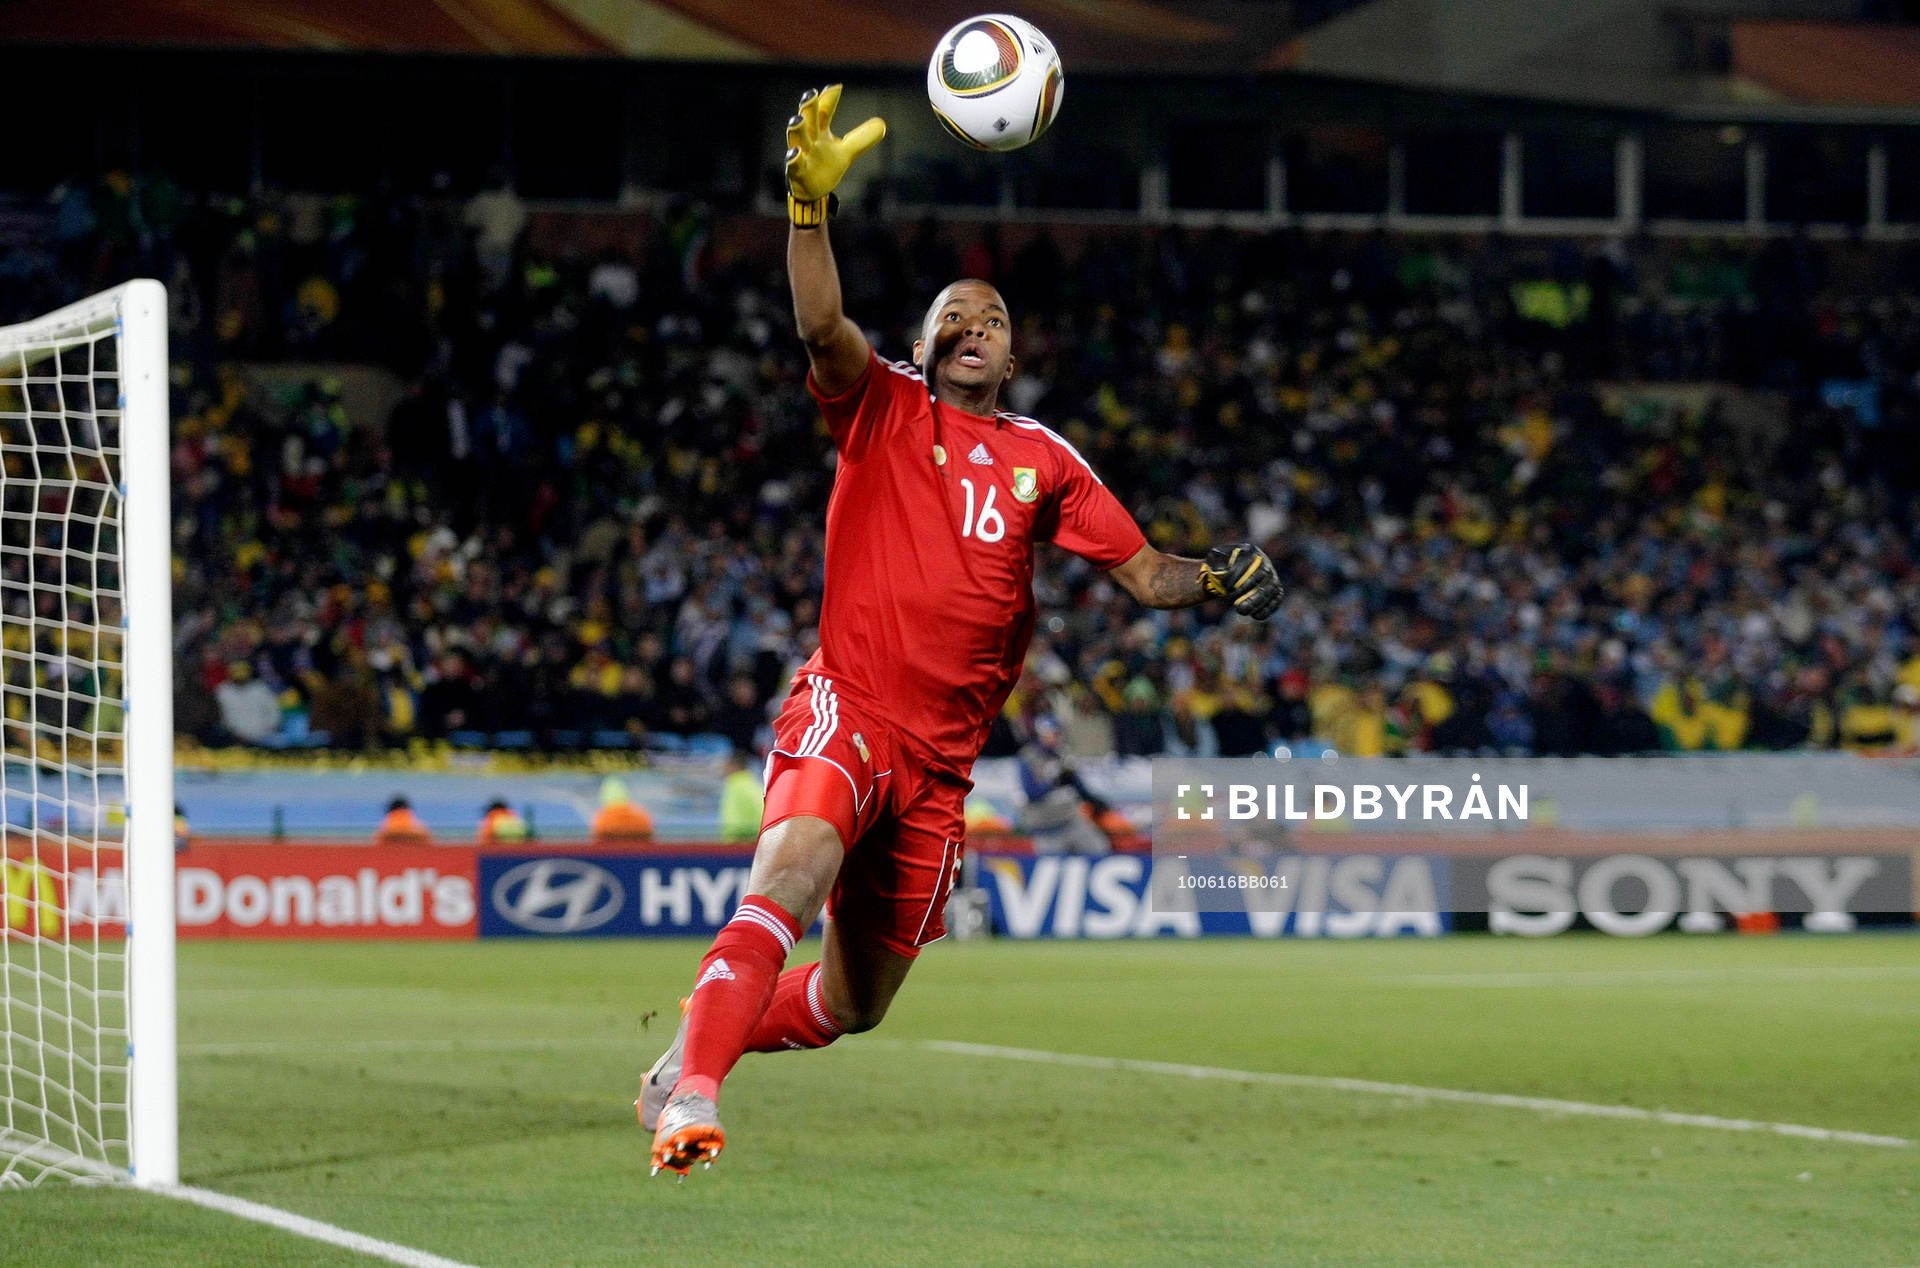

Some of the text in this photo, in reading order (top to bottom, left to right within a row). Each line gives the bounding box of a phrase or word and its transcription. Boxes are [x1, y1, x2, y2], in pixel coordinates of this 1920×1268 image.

[960, 478, 1005, 543] 16
[68, 866, 475, 928] MDonald's
[978, 854, 1200, 938] VISA
[1224, 854, 1443, 938] VISA
[1486, 853, 1879, 936] SONY
